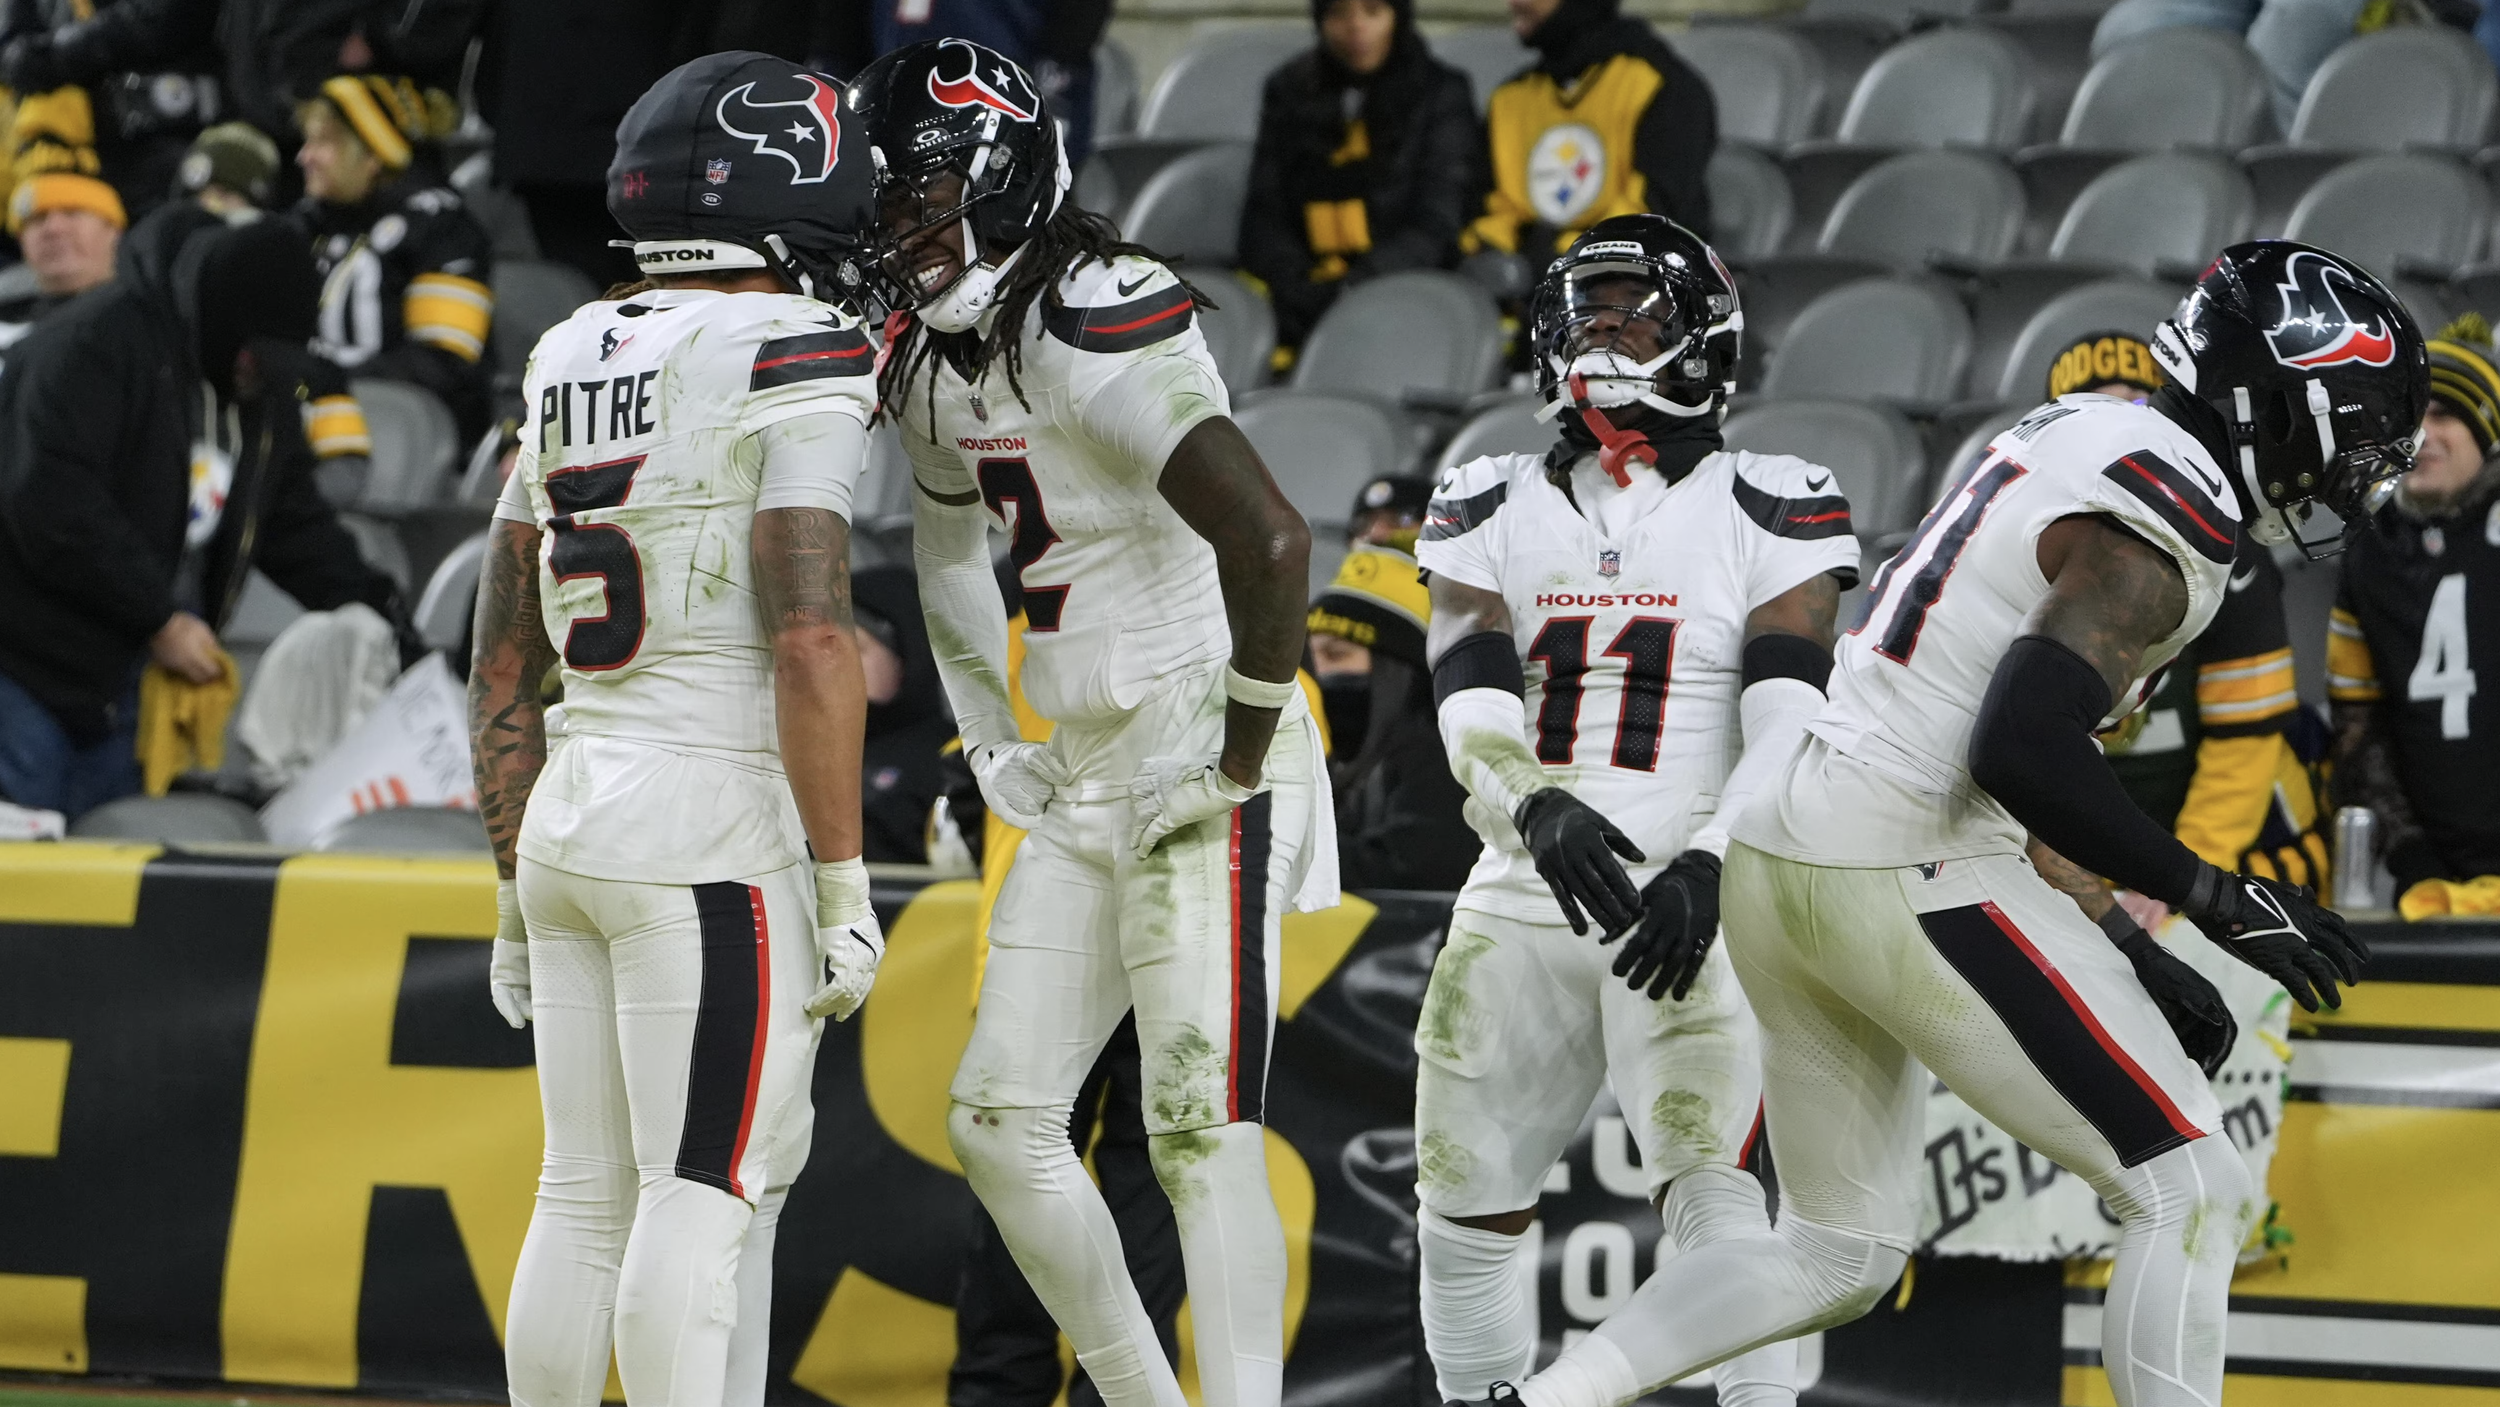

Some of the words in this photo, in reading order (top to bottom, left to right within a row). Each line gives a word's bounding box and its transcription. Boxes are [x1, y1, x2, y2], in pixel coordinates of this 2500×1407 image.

[913, 134, 951, 152] OAKLEY
[708, 169, 726, 181] NFL
[1585, 242, 1637, 251] TEXANS
[540, 369, 660, 453] PITRE
[956, 437, 1027, 451] HOUSTON
[977, 456, 1072, 632] 2
[543, 453, 649, 672] 5
[1600, 560, 1619, 574] NFL
[1536, 594, 1678, 607] HOUSTON
[2408, 572, 2477, 741] 4
[1527, 615, 1686, 773] 11
